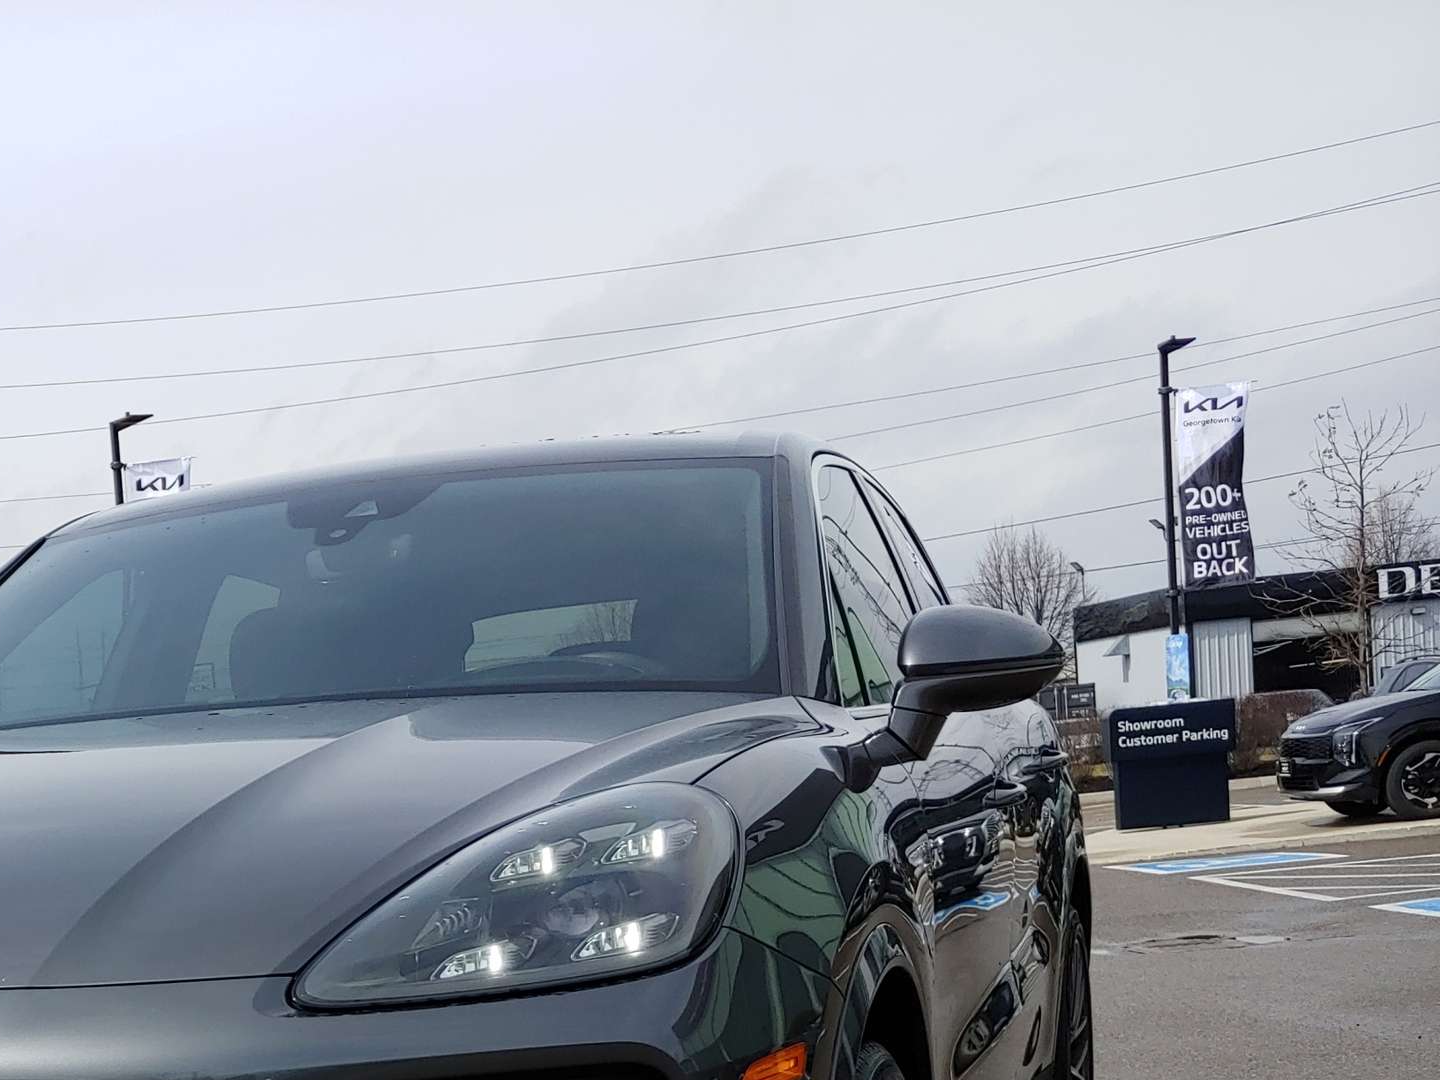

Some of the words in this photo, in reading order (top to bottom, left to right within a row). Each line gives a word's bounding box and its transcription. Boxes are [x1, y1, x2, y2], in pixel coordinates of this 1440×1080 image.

[1183, 396, 1243, 413] KIA
[1183, 417, 1229, 427] Georgetown
[1185, 484, 1241, 510] 200+
[1185, 510, 1247, 524] PRE-OWNED
[1185, 520, 1250, 539] VEHICLES
[1196, 539, 1241, 560] OUT
[1193, 557, 1248, 578] BACK
[1117, 717, 1184, 732] Showroom
[1118, 733, 1178, 748] Customer
[1182, 728, 1229, 741] Parking
